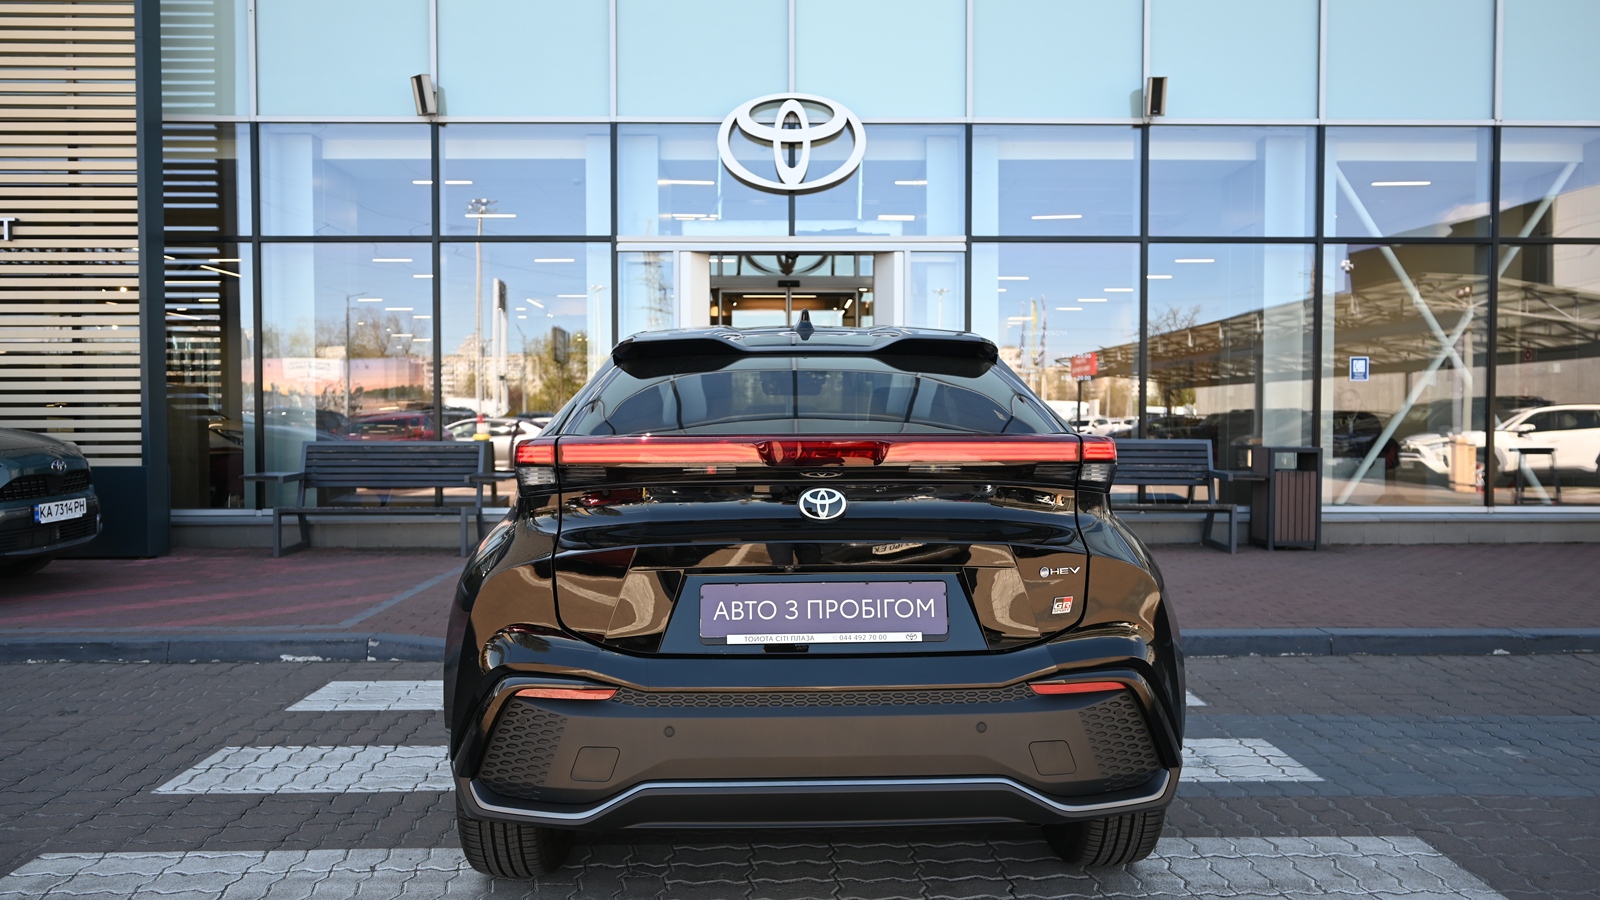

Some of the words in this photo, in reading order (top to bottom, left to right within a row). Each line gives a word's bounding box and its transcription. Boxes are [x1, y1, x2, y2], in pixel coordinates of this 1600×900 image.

[55, 503, 73, 516] 7314
[1050, 566, 1080, 575] HEV
[713, 600, 777, 621] АВТО
[807, 598, 935, 619] ПРОБІГОМ
